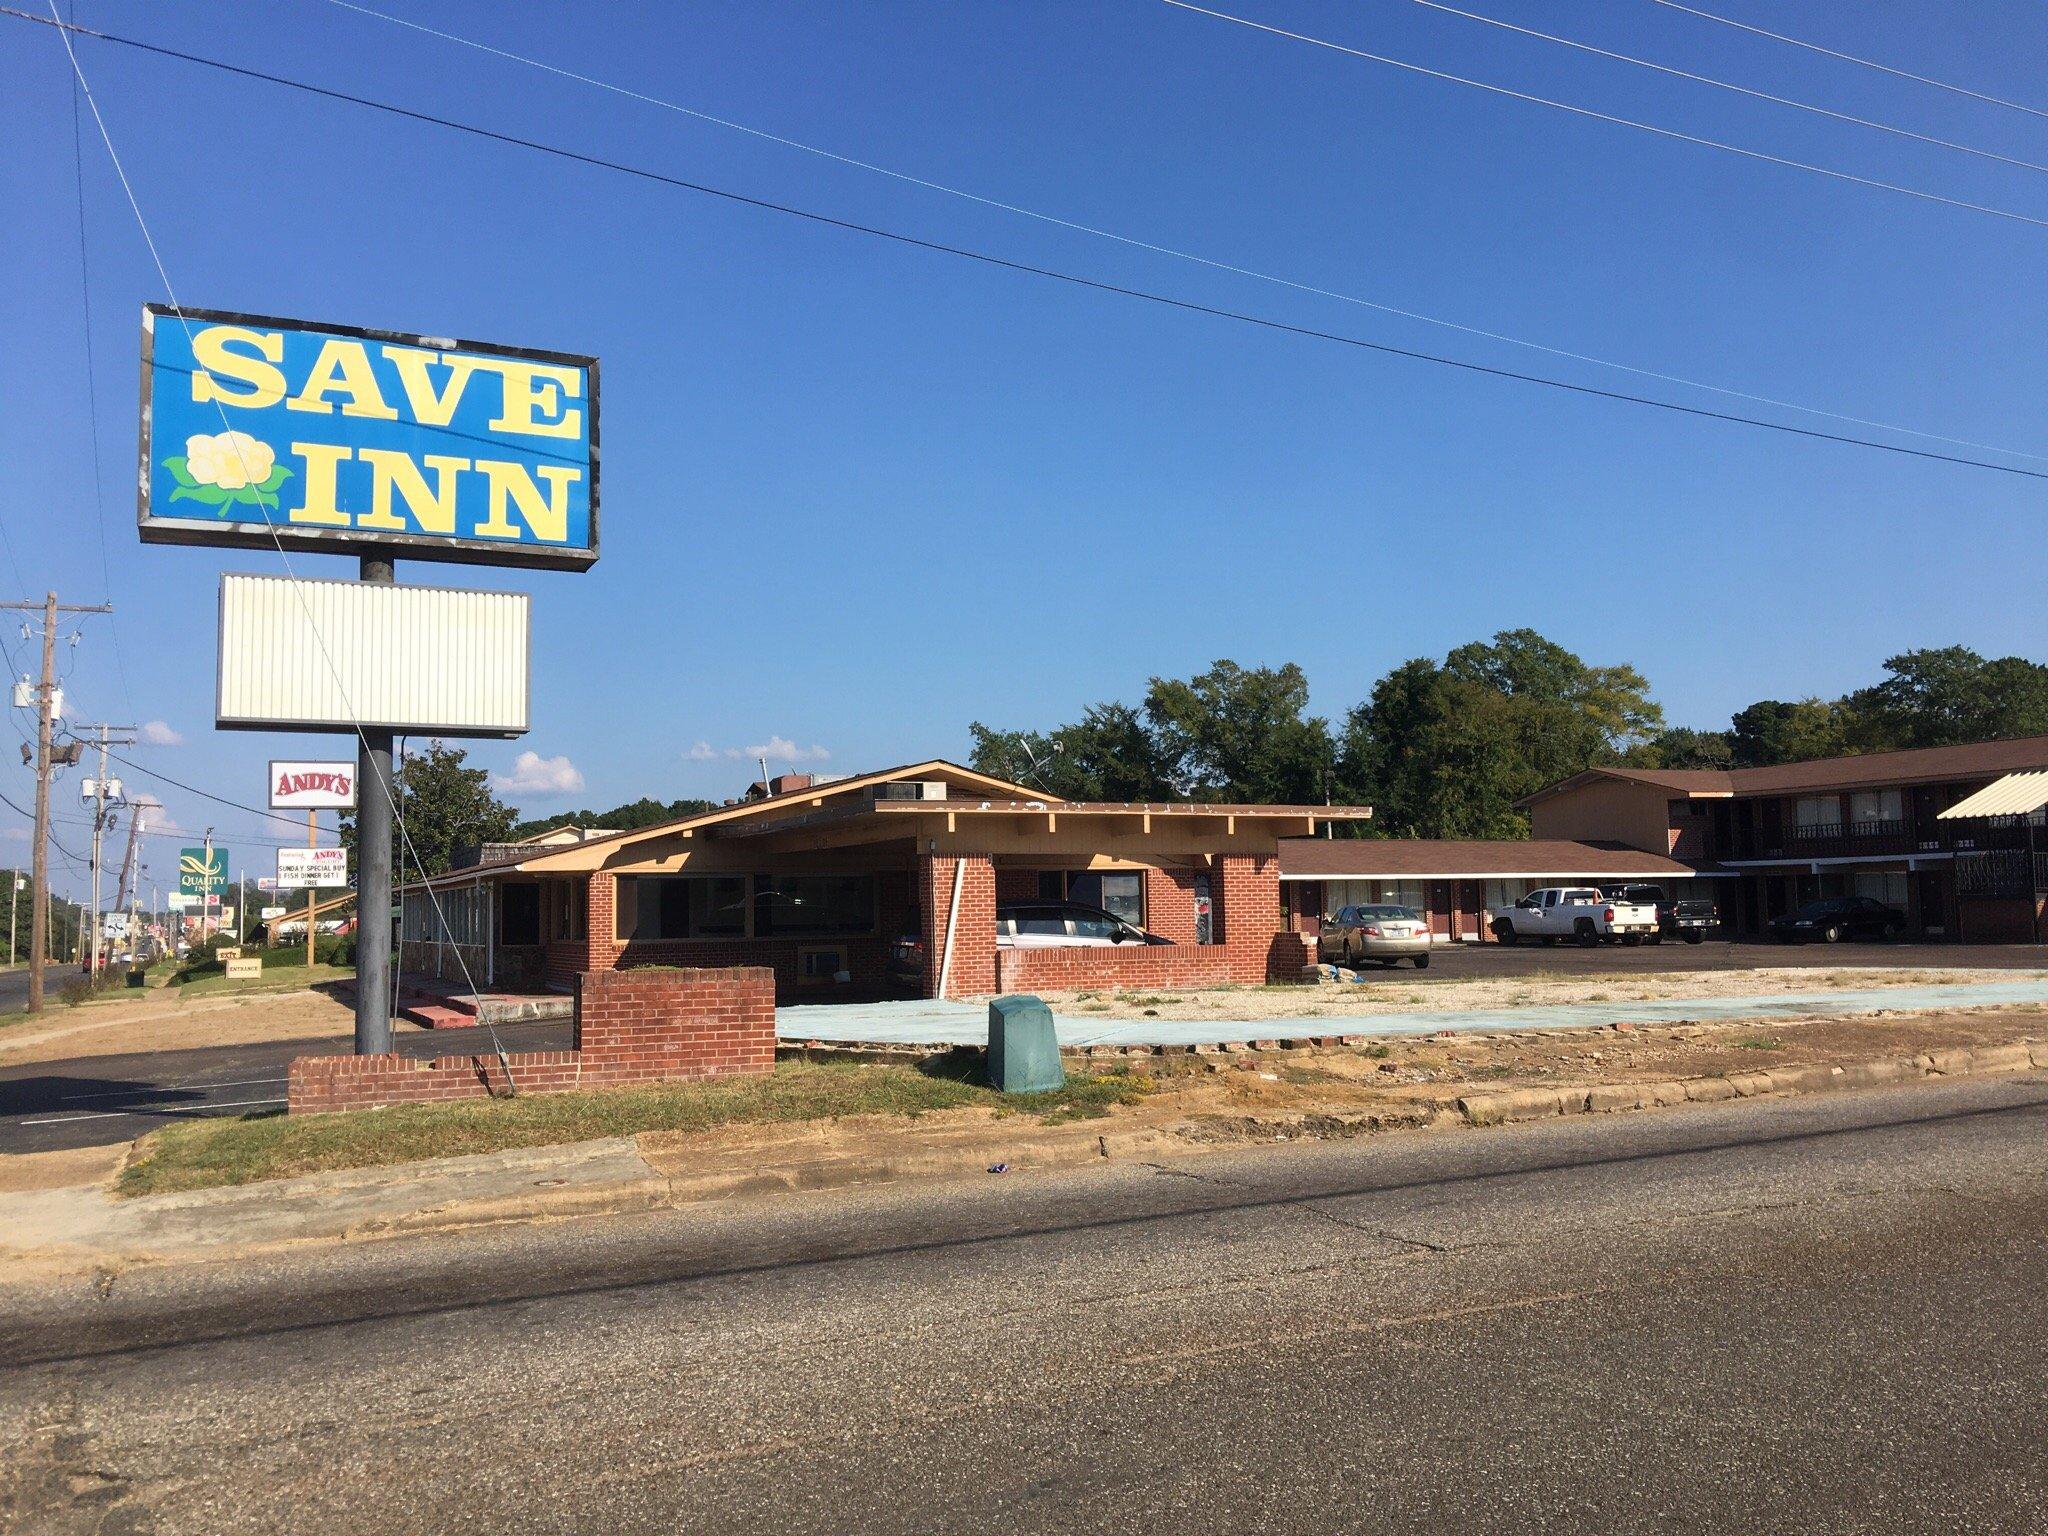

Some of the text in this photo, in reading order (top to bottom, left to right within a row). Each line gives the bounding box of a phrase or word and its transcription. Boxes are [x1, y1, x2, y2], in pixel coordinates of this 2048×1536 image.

[192, 326, 581, 439] SAVE
[289, 442, 581, 541] INN
[275, 772, 351, 796] ANDY'S
[313, 850, 344, 860] ANDY'S
[220, 951, 237, 959] EXIT
